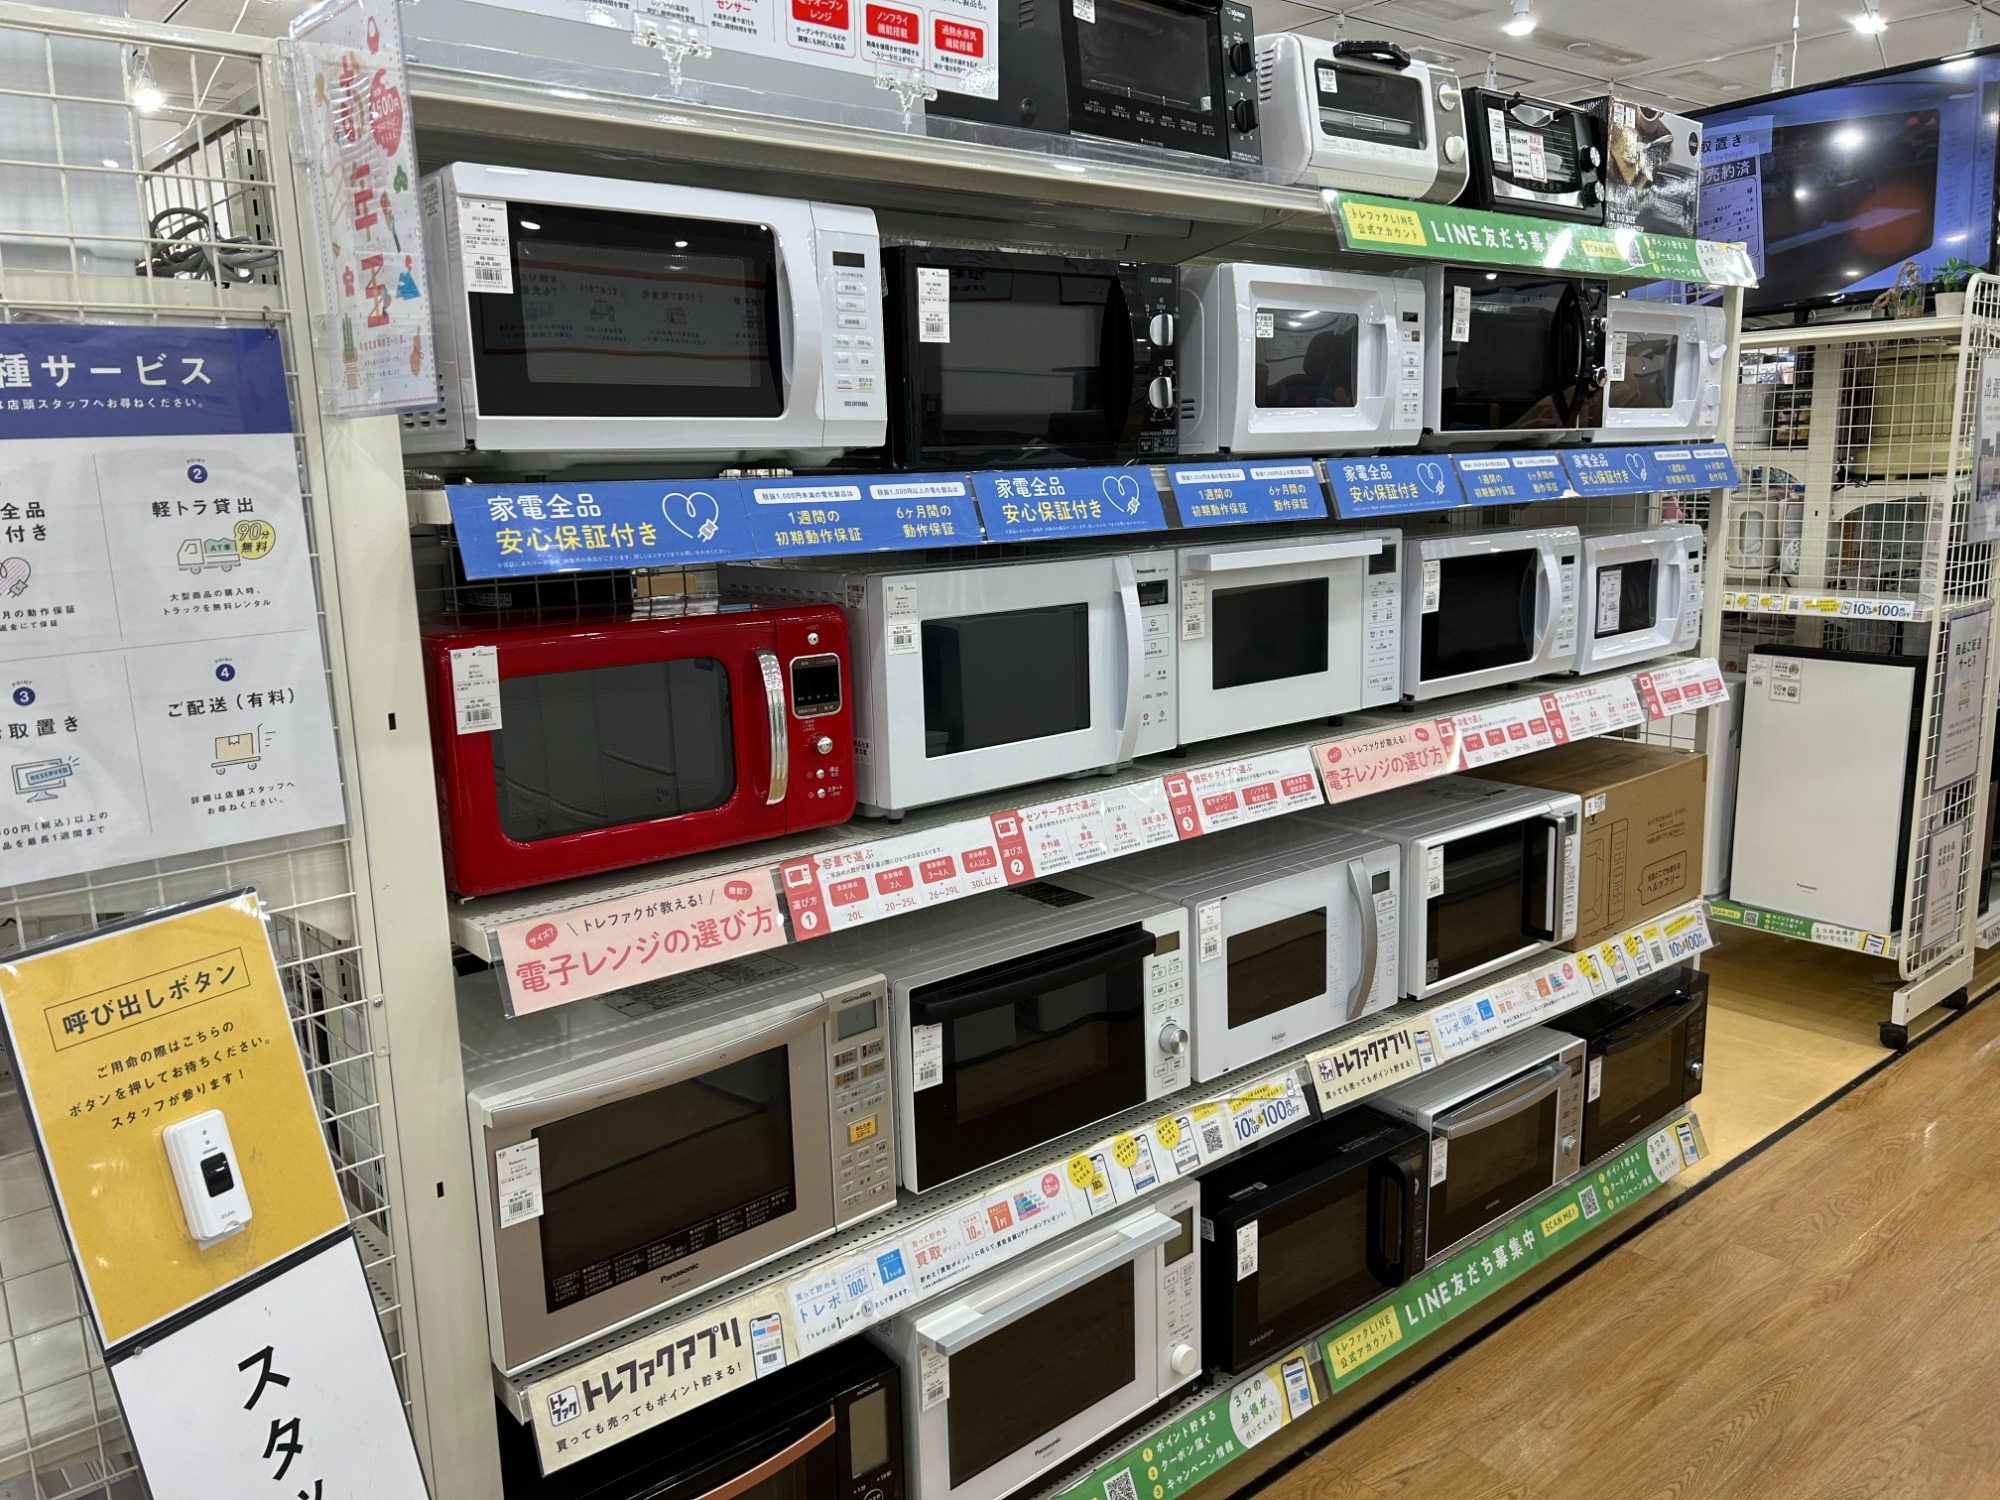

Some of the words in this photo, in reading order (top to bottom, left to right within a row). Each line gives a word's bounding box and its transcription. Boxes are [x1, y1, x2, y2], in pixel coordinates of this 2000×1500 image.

[715, 1, 751, 11] センサー
[810, 9, 832, 21] レンジ
[877, 11, 908, 25] ノンフライ
[796, 26, 846, 42] オーブンやグリルなどの
[877, 23, 909, 39] 機能搭載
[941, 24, 977, 41] 過熱水蒸気
[945, 38, 974, 53] 機能搭載
[1351, 208, 1414, 227] トレファクLINE
[1625, 215, 1636, 224] SIZE
[1357, 225, 1419, 241] 公式アカウント
[1430, 220, 1575, 255] LINE友だち募
[0, 353, 212, 389] 種サービス
[1572, 453, 1609, 468] 家電全品
[193, 468, 203, 480] 2
[1343, 464, 1393, 483] 家電全品
[1477, 474, 1503, 485] 1週間の
[1579, 468, 1631, 486] 安心保証付き
[762, 490, 853, 500] 税抜1,000円未満の電化製品は
[877, 486, 959, 497] 税抜1,000円以上の電化製品は
[994, 476, 1066, 499] 家電全品
[1198, 488, 1233, 500] 1週間の
[1269, 485, 1306, 496] 6ヶ月間の
[1349, 482, 1419, 504] 安心保証付き
[1473, 484, 1516, 498] 初期動作保証
[1533, 481, 1560, 493] 動作保証
[0, 501, 46, 521] 全品
[152, 497, 255, 518] 軽トラ貸出
[487, 493, 602, 522] 家電全品
[787, 510, 840, 525] 1週間の
[896, 504, 951, 520] 6ヶ月間の
[1002, 499, 1102, 524] 安心保証付き
[1191, 502, 1249, 517] 初期動作保証
[1273, 499, 1309, 512] 動作保証
[5, 524, 48, 543] 付き
[237, 522, 271, 541] 90分
[495, 521, 657, 556] 安心保証付き
[775, 527, 863, 546] 初期動作保証
[902, 522, 956, 538] 動作保証
[210, 543, 232, 553] AT車
[241, 541, 268, 554] 無料
[170, 586, 263, 602] 大型商品の購入時、
[2, 606, 76, 620] 月の動作保証
[163, 599, 272, 616] トラックを無料レンタル
[220, 667, 231, 678] 4
[19, 691, 29, 702] 3
[168, 687, 297, 718] ご配送（有料）
[9, 715, 80, 740] 取置き
[1352, 734, 1408, 755] トレファクが教える!
[29, 766, 70, 782] RESERVED
[1192, 763, 1253, 785] 機能やタイプで選ぶ
[1326, 748, 1444, 791] 電子レンジの選び方
[191, 781, 295, 804] 詳細は店舗スタッフへ
[207, 798, 284, 815] お尋ねください。
[1026, 799, 1097, 822] センサー方式で選ぶ
[1175, 805, 1193, 816] 選び方
[1215, 803, 1228, 811] レンジ
[1186, 819, 1192, 830] 3
[3, 826, 105, 851] 品を最長1週間まで
[1113, 831, 1134, 840] センサー
[822, 849, 875, 870] 容量で選ぶ
[1003, 846, 1024, 857] 選び方
[968, 858, 992, 869] 4人以上
[1014, 861, 1020, 873] 2
[927, 868, 950, 880] 3〜4人
[970, 875, 999, 890] 30L以上
[1647, 875, 1681, 892] ヘルツフリー
[728, 886, 748, 895] 機能?
[890, 880, 901, 889] 2人
[928, 885, 960, 900] 26〜29L
[792, 896, 818, 911] 選び方
[844, 891, 856, 900] 1人
[884, 897, 917, 912] 20〜25L
[584, 892, 703, 932] トレファクが教える!
[806, 914, 812, 927] 1
[847, 911, 864, 922] 20L
[529, 927, 555, 946] サイズ?
[516, 905, 773, 993] 電子レンジの選び方
[62, 965, 236, 1036] 呼び出しボタン
[1271, 1031, 1287, 1043] Haier
[1438, 1021, 1461, 1038] トレポ
[96, 1021, 235, 1079] ご用命の際はこちらの
[1333, 1030, 1412, 1078] トレファクアプリ
[69, 1037, 271, 1117] ボタンを押してお待ちください。
[1325, 1059, 1415, 1101] 買っても売ってもポイント貯まる!
[111, 1069, 246, 1130] スタッフが参ります!
[856, 1121, 872, 1132] あたため
[1234, 1116, 1256, 1141] 10%
[1251, 1125, 1261, 1134] UP
[1261, 1099, 1293, 1128] 100円
[1287, 1104, 1301, 1117] OFF
[856, 1129, 872, 1139] スタート
[1606, 1152, 1640, 1178] ポイント貯まる
[994, 1215, 1008, 1230] 1PT
[1544, 1215, 1563, 1232] SCAN
[1562, 1207, 1577, 1224] ME!
[911, 1227, 949, 1248] 売って貯める
[966, 1225, 982, 1241] 10円
[915, 1239, 962, 1270] 買取ポイント
[660, 1262, 700, 1284] Panasonic
[882, 1264, 904, 1282] 1トレポ
[1405, 1228, 1536, 1326] LINE友だち募集中
[795, 1278, 838, 1303] 買って貯める
[799, 1291, 843, 1325] トレポ
[1249, 1329, 1275, 1346] SHARP
[1335, 1314, 1391, 1356] トレファクLINE
[1340, 1328, 1394, 1370] 公式アカウント
[581, 1317, 743, 1412] トレファクアプリ
[549, 1391, 567, 1411] トレ
[1234, 1379, 1262, 1408] 3つの
[552, 1403, 578, 1423] ファク
[556, 1362, 743, 1454] 買っても売ってもポイント貯まる!
[1241, 1396, 1268, 1425] お得が
[1156, 1410, 1217, 1454] ポイント貯まる
[1245, 1410, 1277, 1442] 付いてくる!
[1161, 1433, 1212, 1472] クーポン届く
[1166, 1440, 1235, 1490] キャンペーン情報
